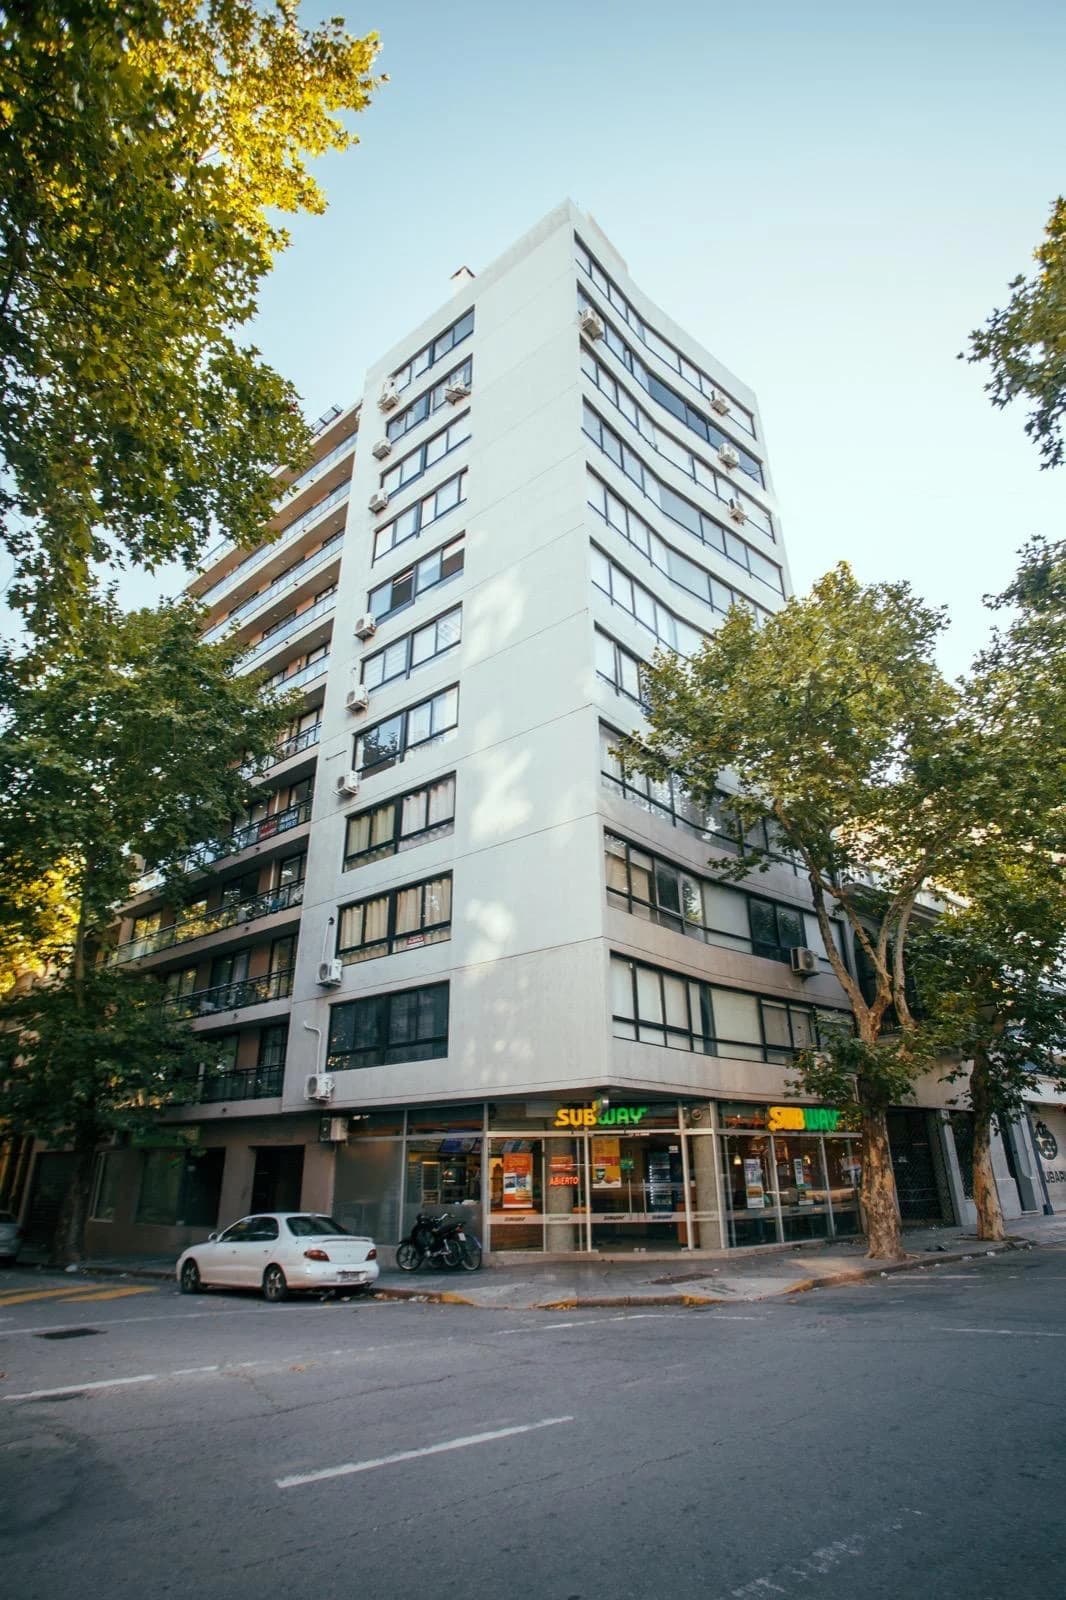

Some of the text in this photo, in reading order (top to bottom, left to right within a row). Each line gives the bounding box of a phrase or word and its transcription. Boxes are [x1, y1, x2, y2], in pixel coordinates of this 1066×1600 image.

[554, 1107, 647, 1127] SUBWAY
[768, 1106, 839, 1131] SUBWAY
[549, 1176, 580, 1187] ABIERTO
